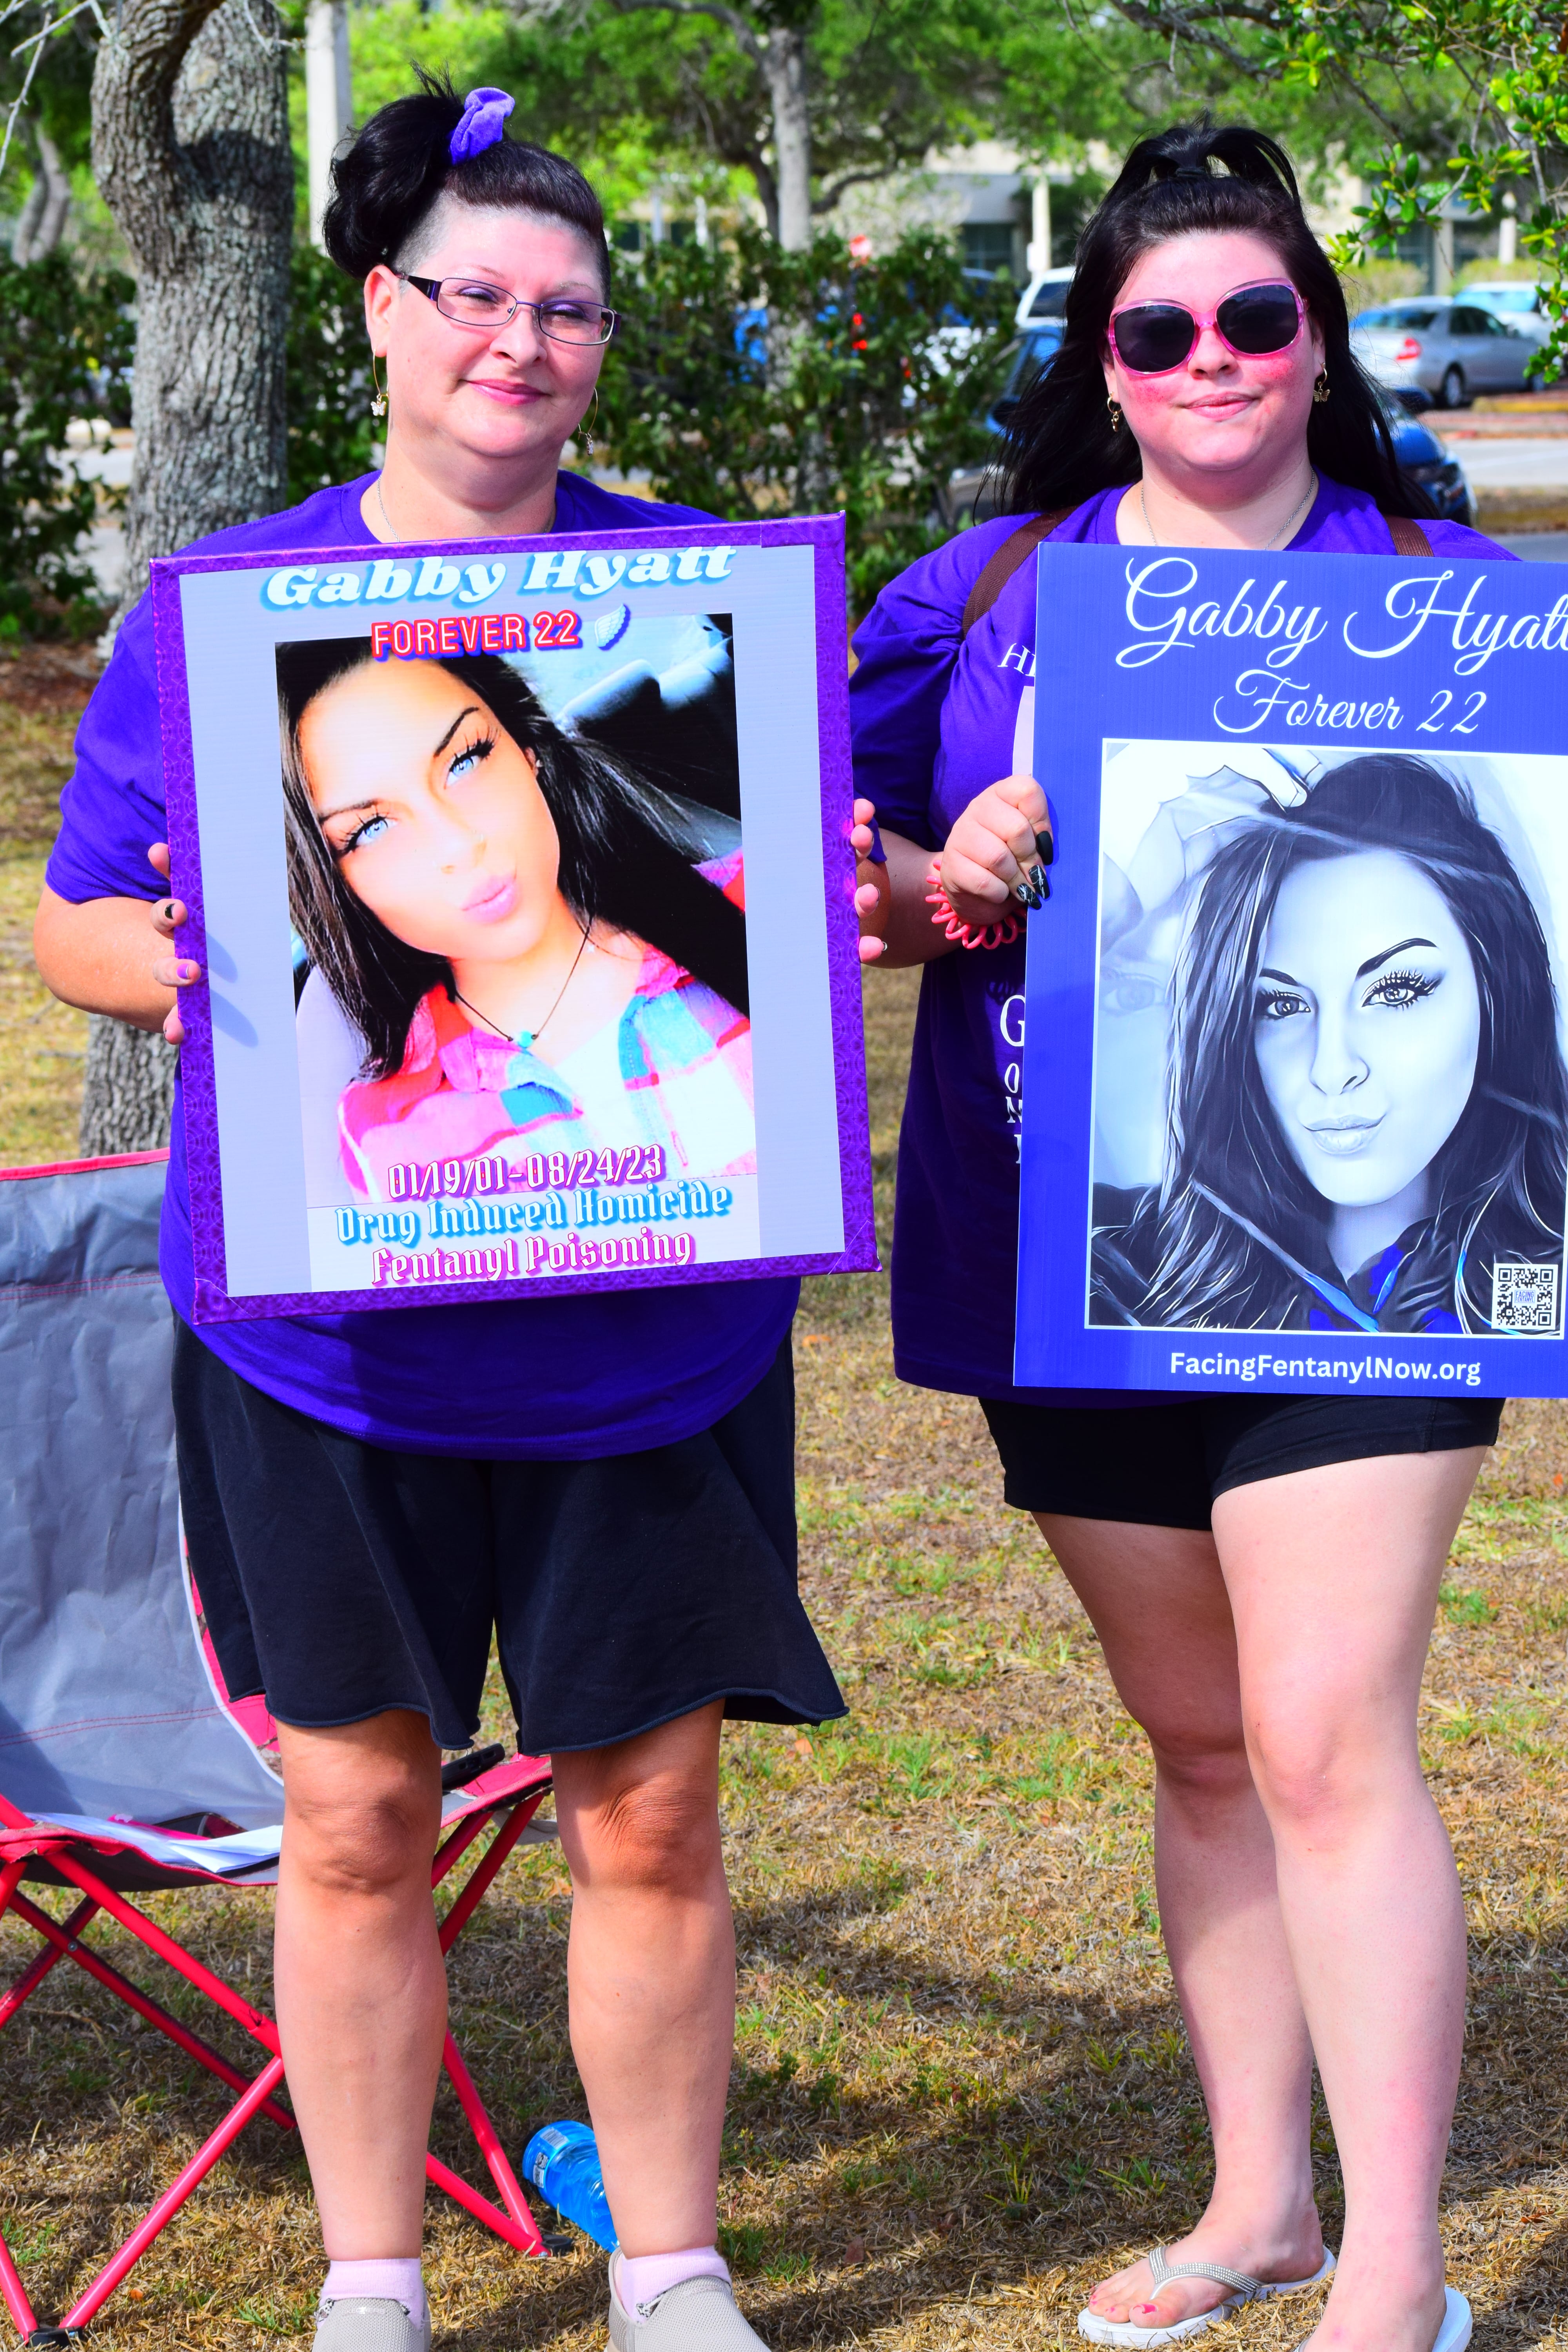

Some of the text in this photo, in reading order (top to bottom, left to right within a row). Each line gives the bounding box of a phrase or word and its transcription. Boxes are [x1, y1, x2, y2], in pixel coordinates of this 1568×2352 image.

[263, 545, 737, 608] Gabby Hyatt
[372, 610, 579, 657] FOREVER 22
[1116, 557, 1328, 668] Gabby
[1214, 669, 1487, 733] Forever 22
[335, 1181, 729, 1244] Drug Induced Homicide
[372, 1226, 691, 1285] Fentanyl Poisoning
[1170, 1352, 1481, 1386] FacingFentanylNow.org
